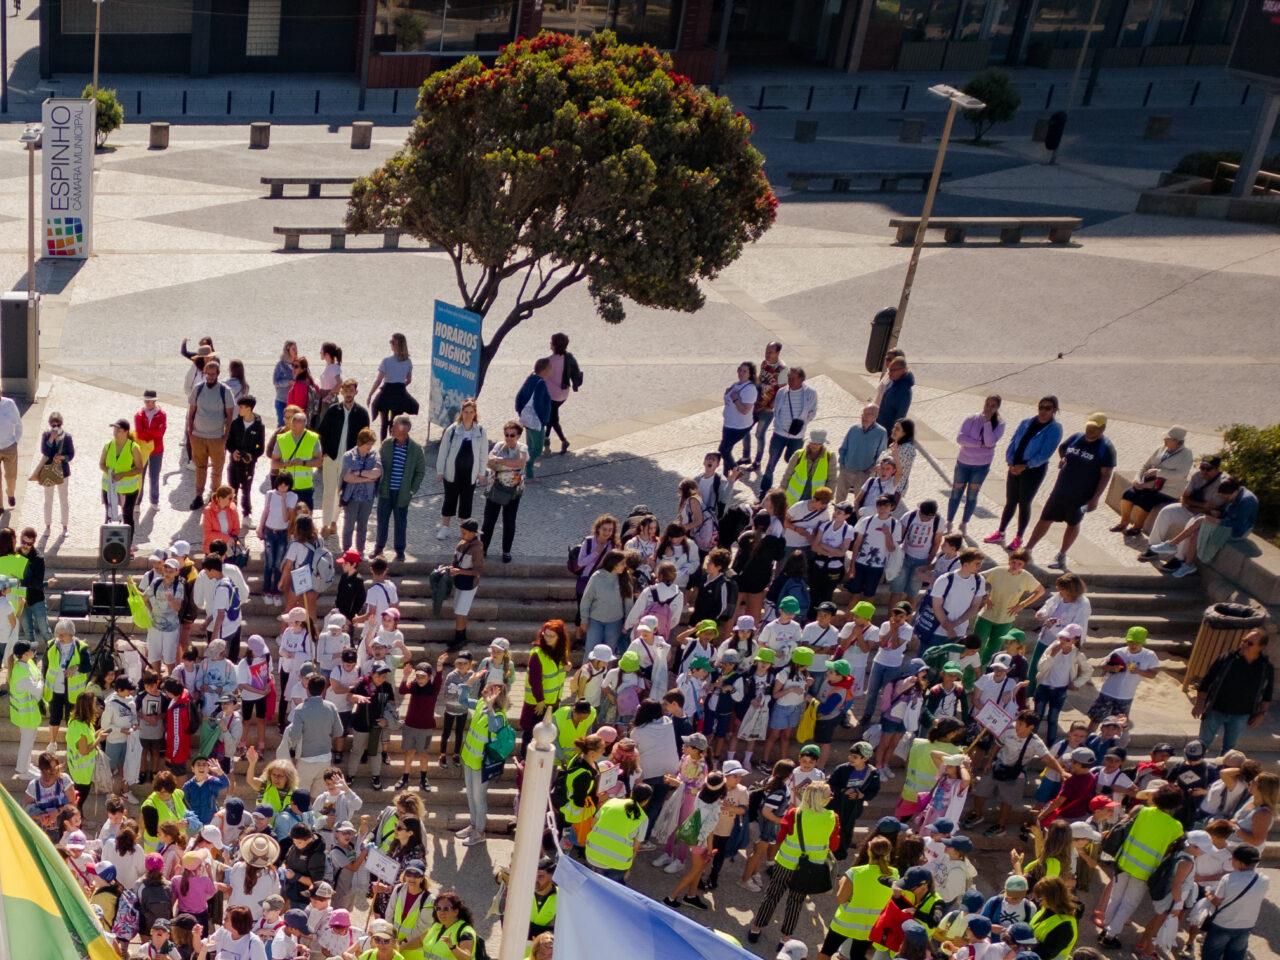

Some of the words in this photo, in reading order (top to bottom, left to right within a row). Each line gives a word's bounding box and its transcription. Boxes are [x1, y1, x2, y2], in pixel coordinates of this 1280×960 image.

[50, 105, 71, 211] ESPINHO
[73, 107, 84, 164] MUNICIPAL
[71, 166, 83, 211] CÂMARA
[435, 321, 478, 350] HORÁRIOS
[439, 341, 471, 366] DIGNOS
